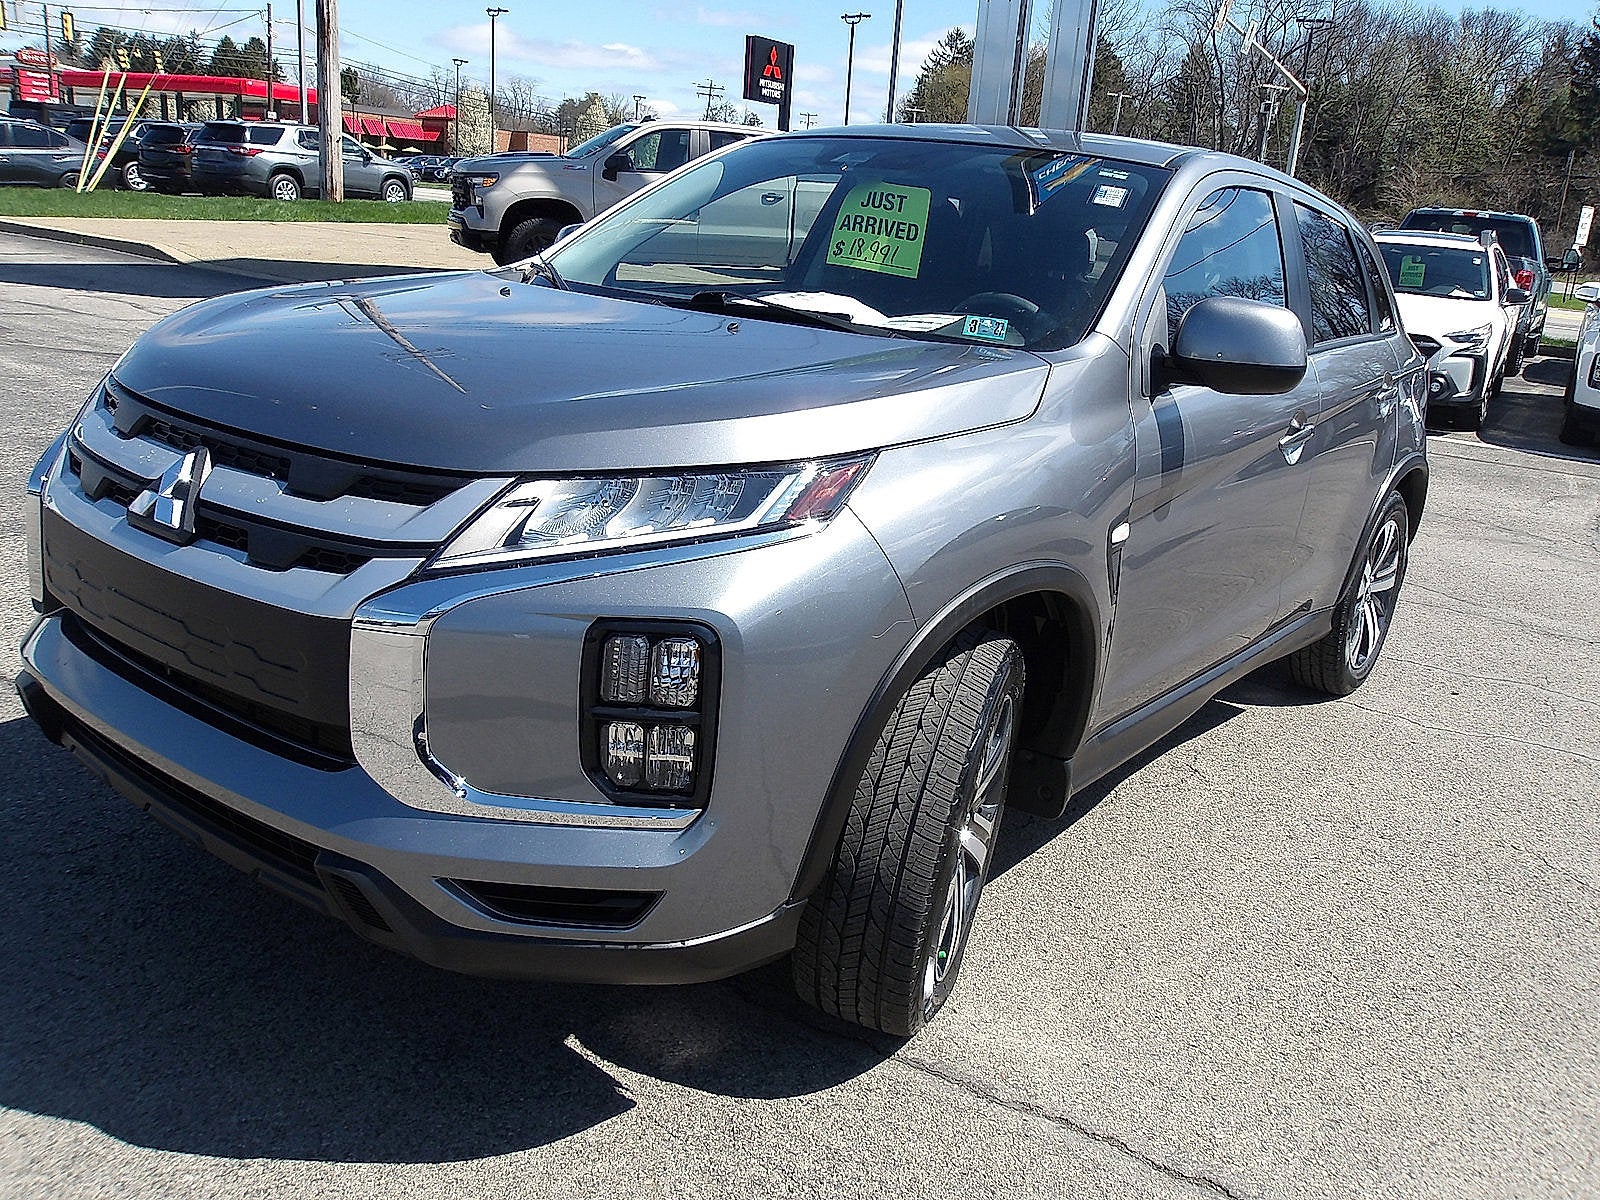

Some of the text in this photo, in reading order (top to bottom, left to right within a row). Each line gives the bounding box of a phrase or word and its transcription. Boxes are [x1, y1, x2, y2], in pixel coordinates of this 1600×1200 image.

[759, 78, 784, 91] MITSUBISHI
[762, 88, 781, 99] MOTORS
[861, 191, 908, 213] JUST
[838, 214, 919, 241] ARRIVED
[968, 319, 979, 333] 3
